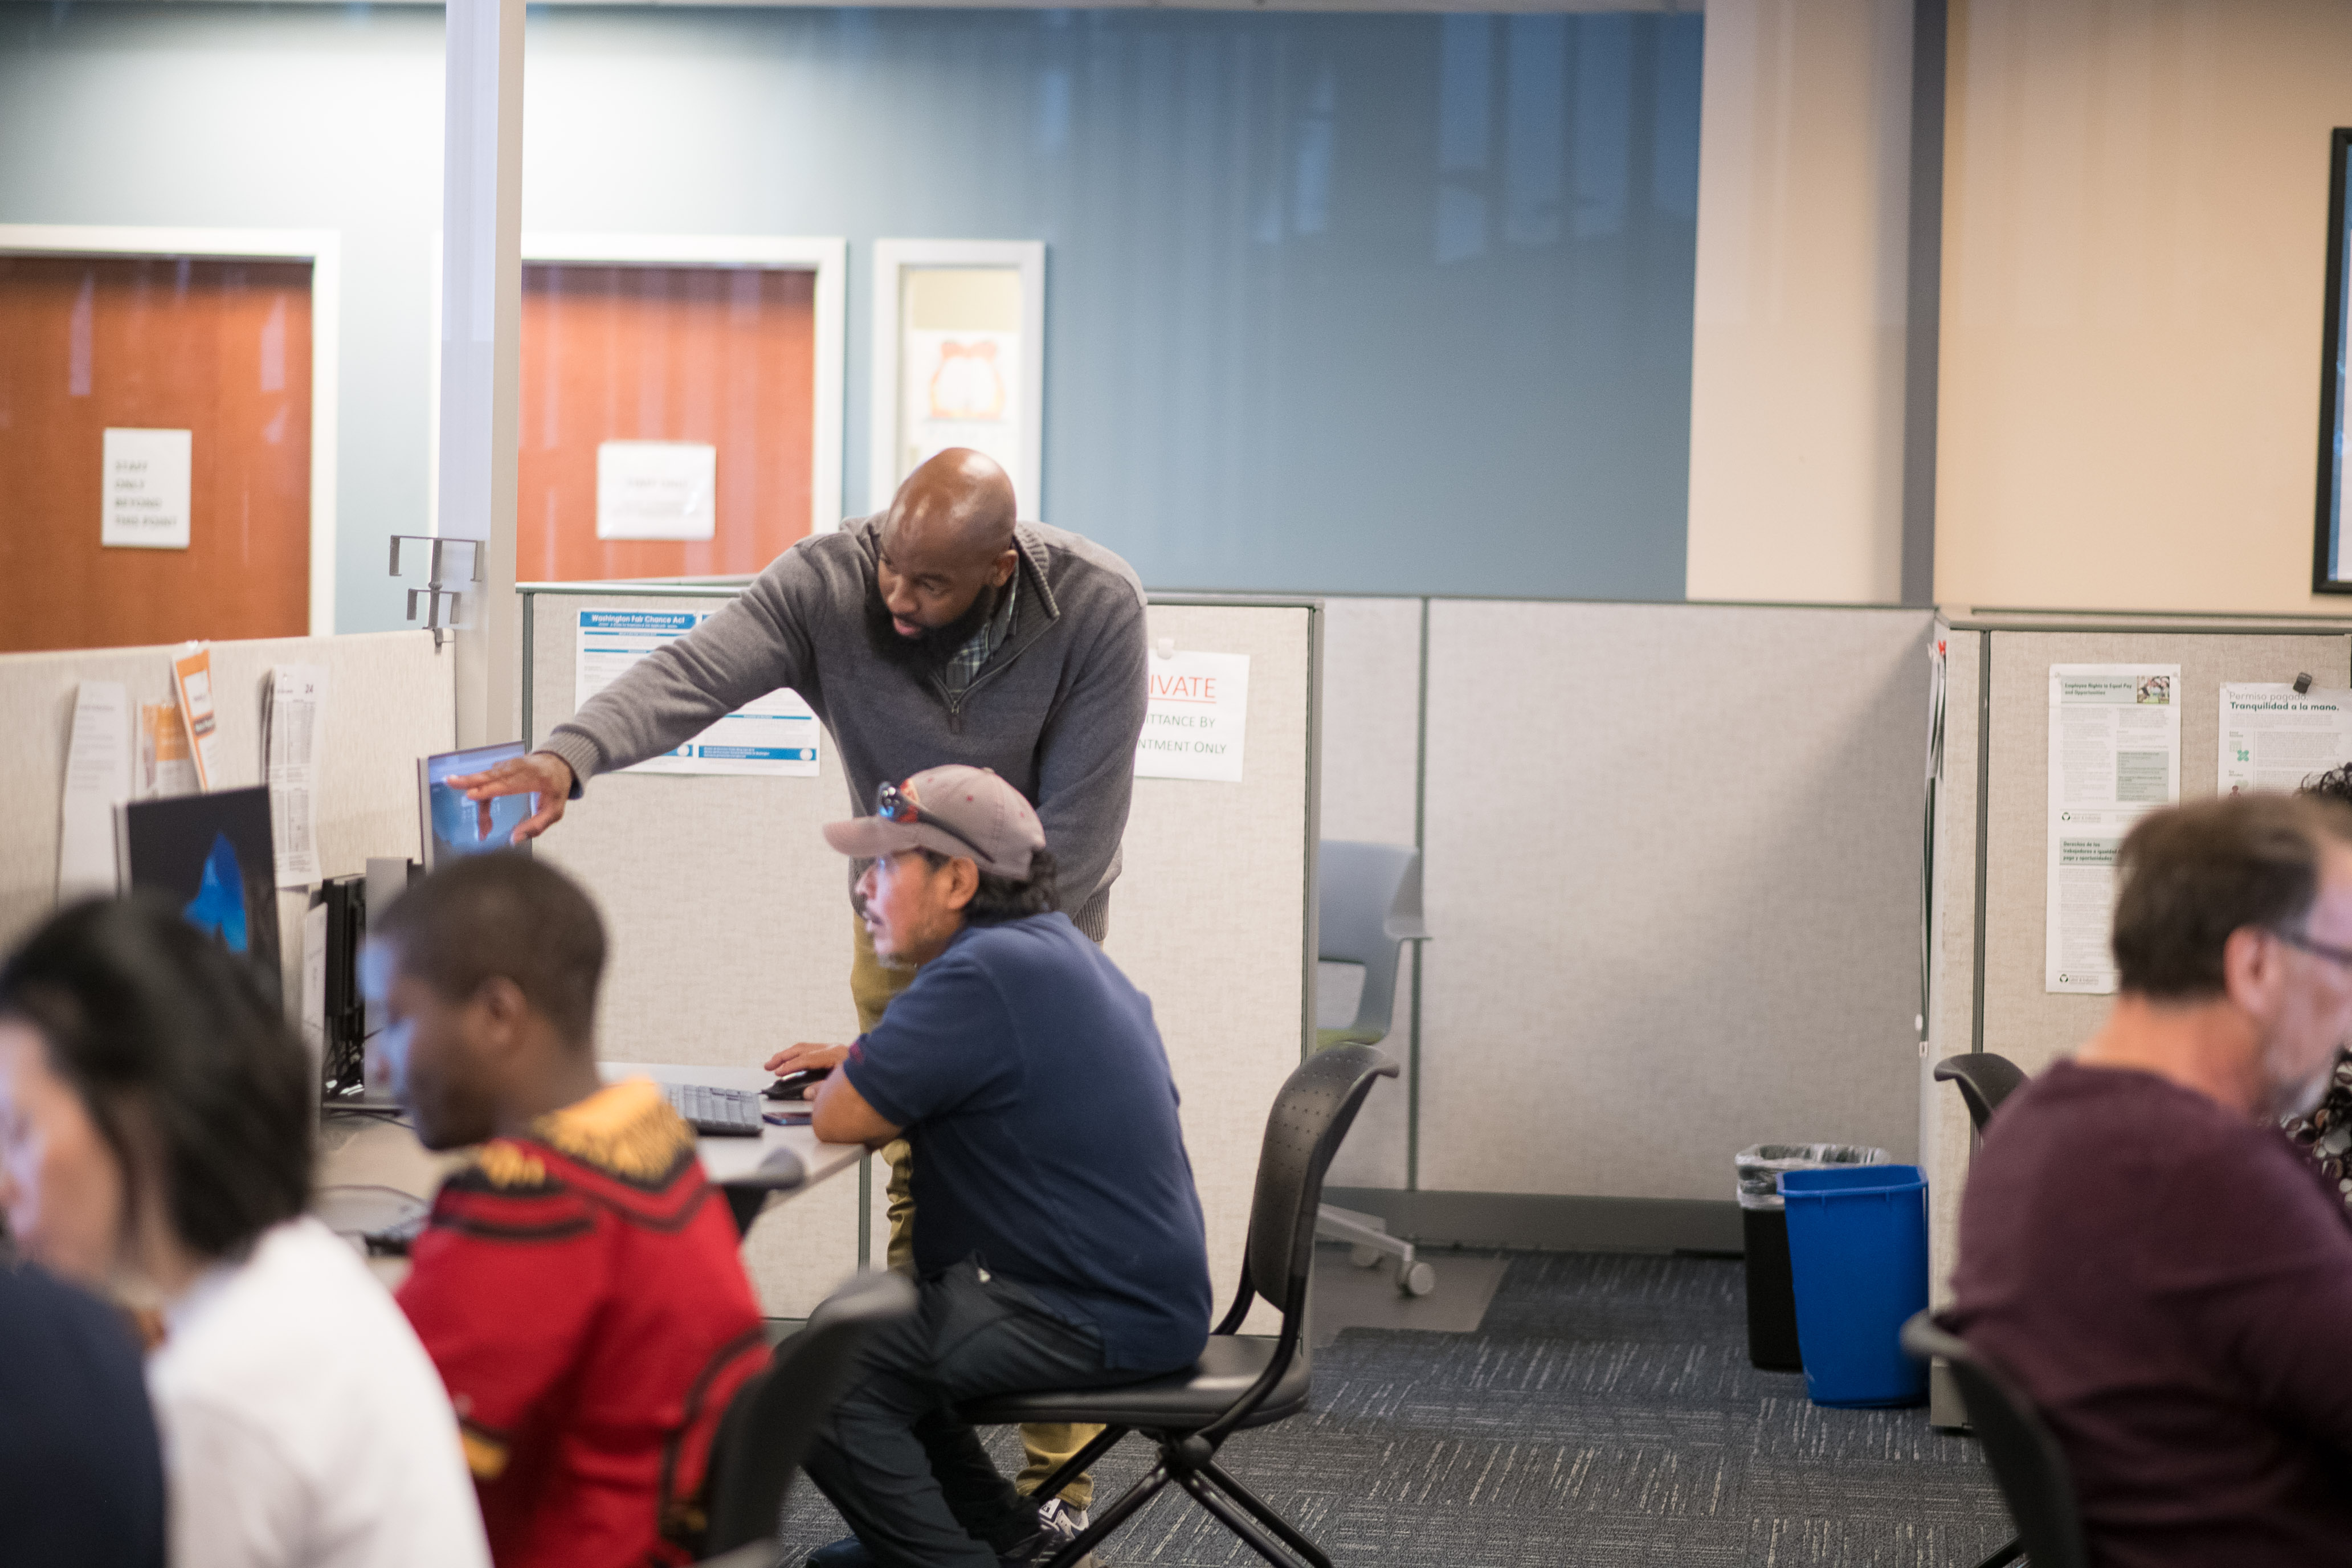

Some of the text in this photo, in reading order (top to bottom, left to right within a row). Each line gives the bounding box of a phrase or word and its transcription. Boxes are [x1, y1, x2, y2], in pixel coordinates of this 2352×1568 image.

[592, 614, 630, 623] Washington
[1150, 674, 1217, 699] IVATE
[2230, 692, 2309, 703] Permiso pagado.
[2230, 702, 2289, 712] Tranquilidad
[1146, 714, 1195, 727] ITTANCE
[1138, 739, 1227, 754] NTMENT ONLY
